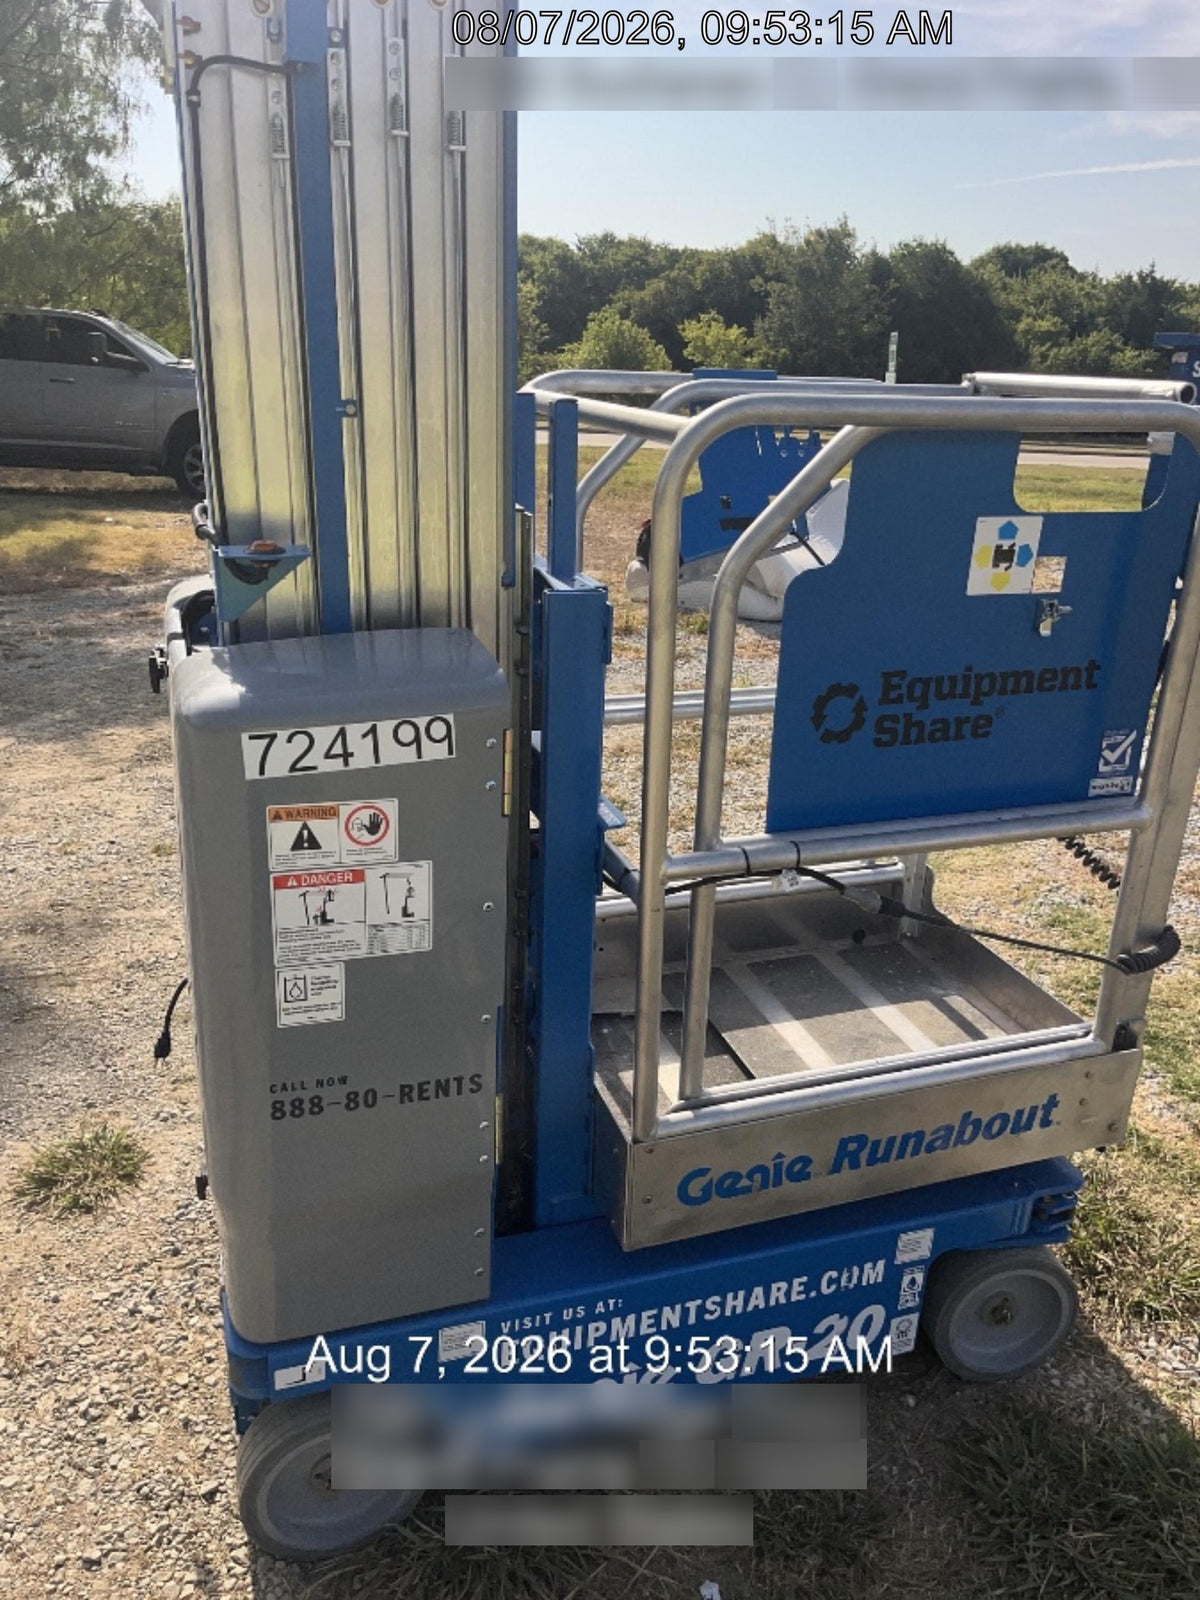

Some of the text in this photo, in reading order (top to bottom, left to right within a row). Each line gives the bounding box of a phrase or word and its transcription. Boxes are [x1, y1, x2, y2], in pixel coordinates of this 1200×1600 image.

[878, 659, 1101, 711] Equipment
[248, 716, 454, 776] 724199
[873, 713, 994, 748] Share
[284, 806, 337, 819] WARNING
[301, 871, 353, 886] DANGER
[269, 1075, 348, 1094] CALL NOW
[270, 1073, 483, 1121] 888-80-RENTS
[829, 1093, 1060, 1176] Runabout
[501, 1299, 623, 1334] VISIT US AT:
